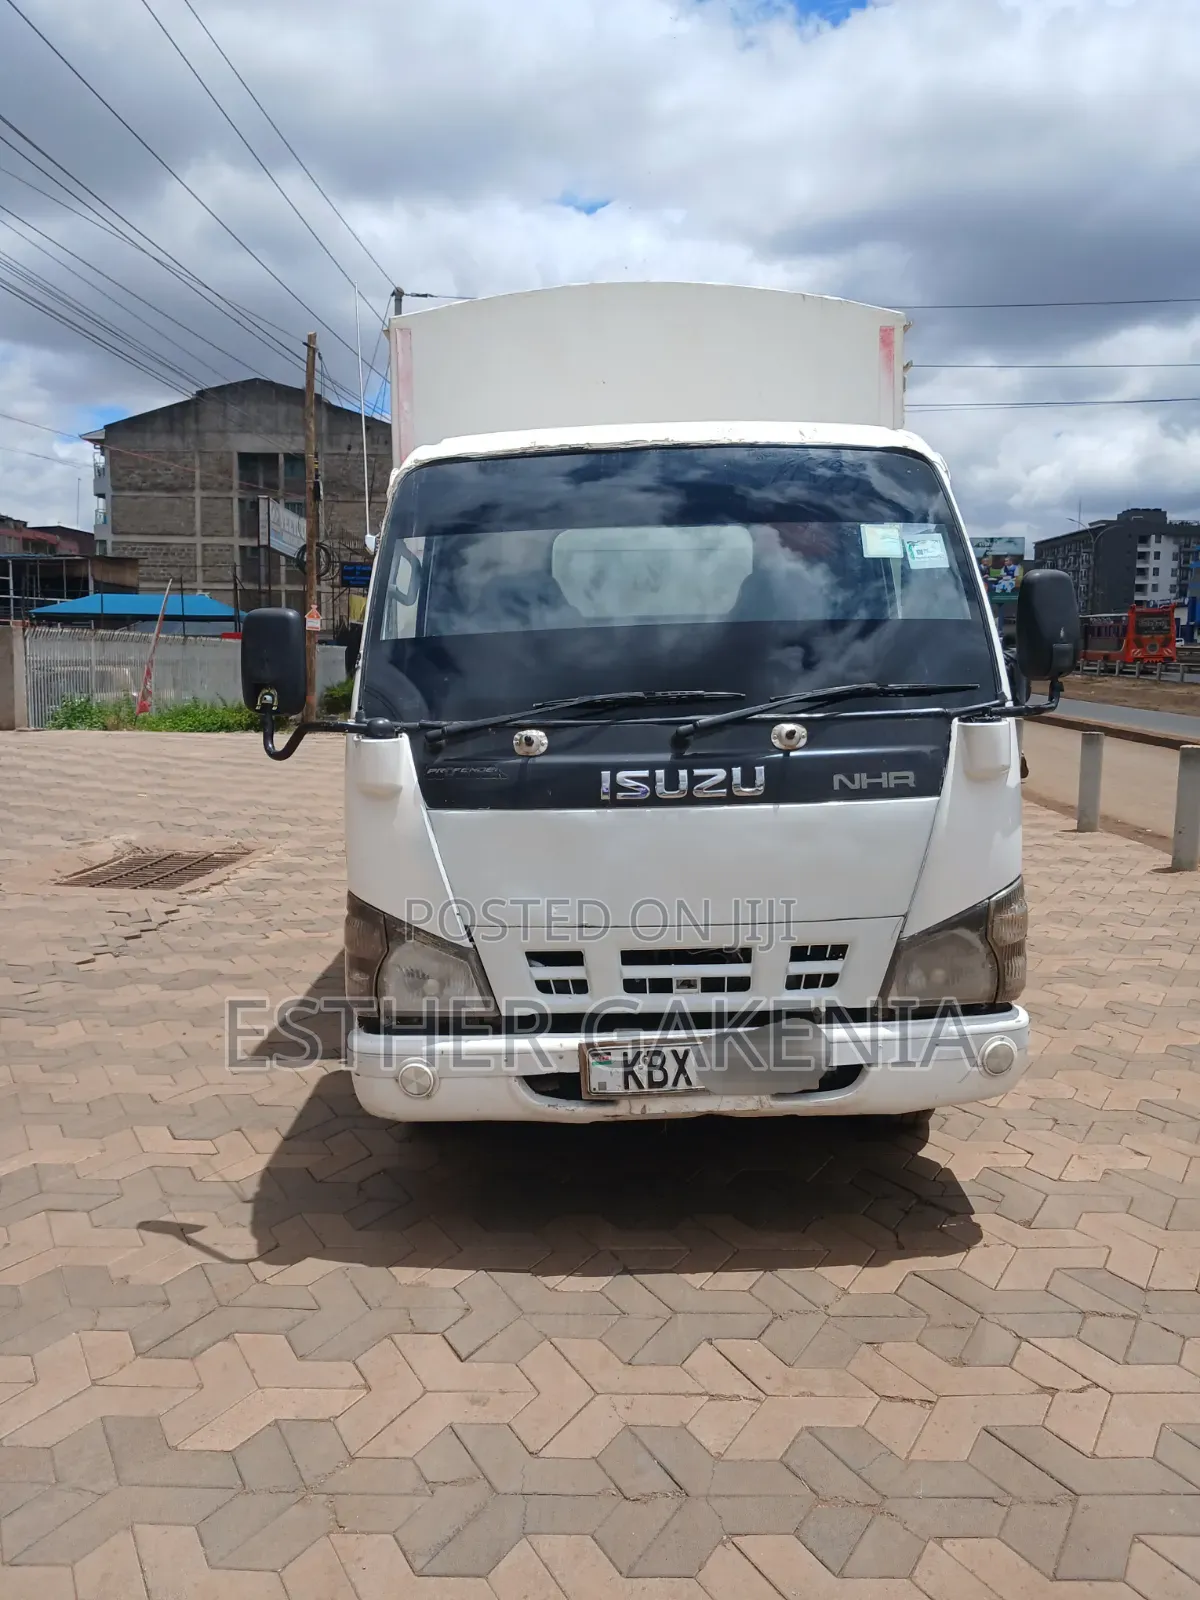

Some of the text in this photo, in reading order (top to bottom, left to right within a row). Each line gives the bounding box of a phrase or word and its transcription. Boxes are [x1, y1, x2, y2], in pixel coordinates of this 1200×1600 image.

[600, 766, 765, 800] ISUZU
[832, 770, 916, 791] NHR
[622, 1048, 693, 1091] KBX
